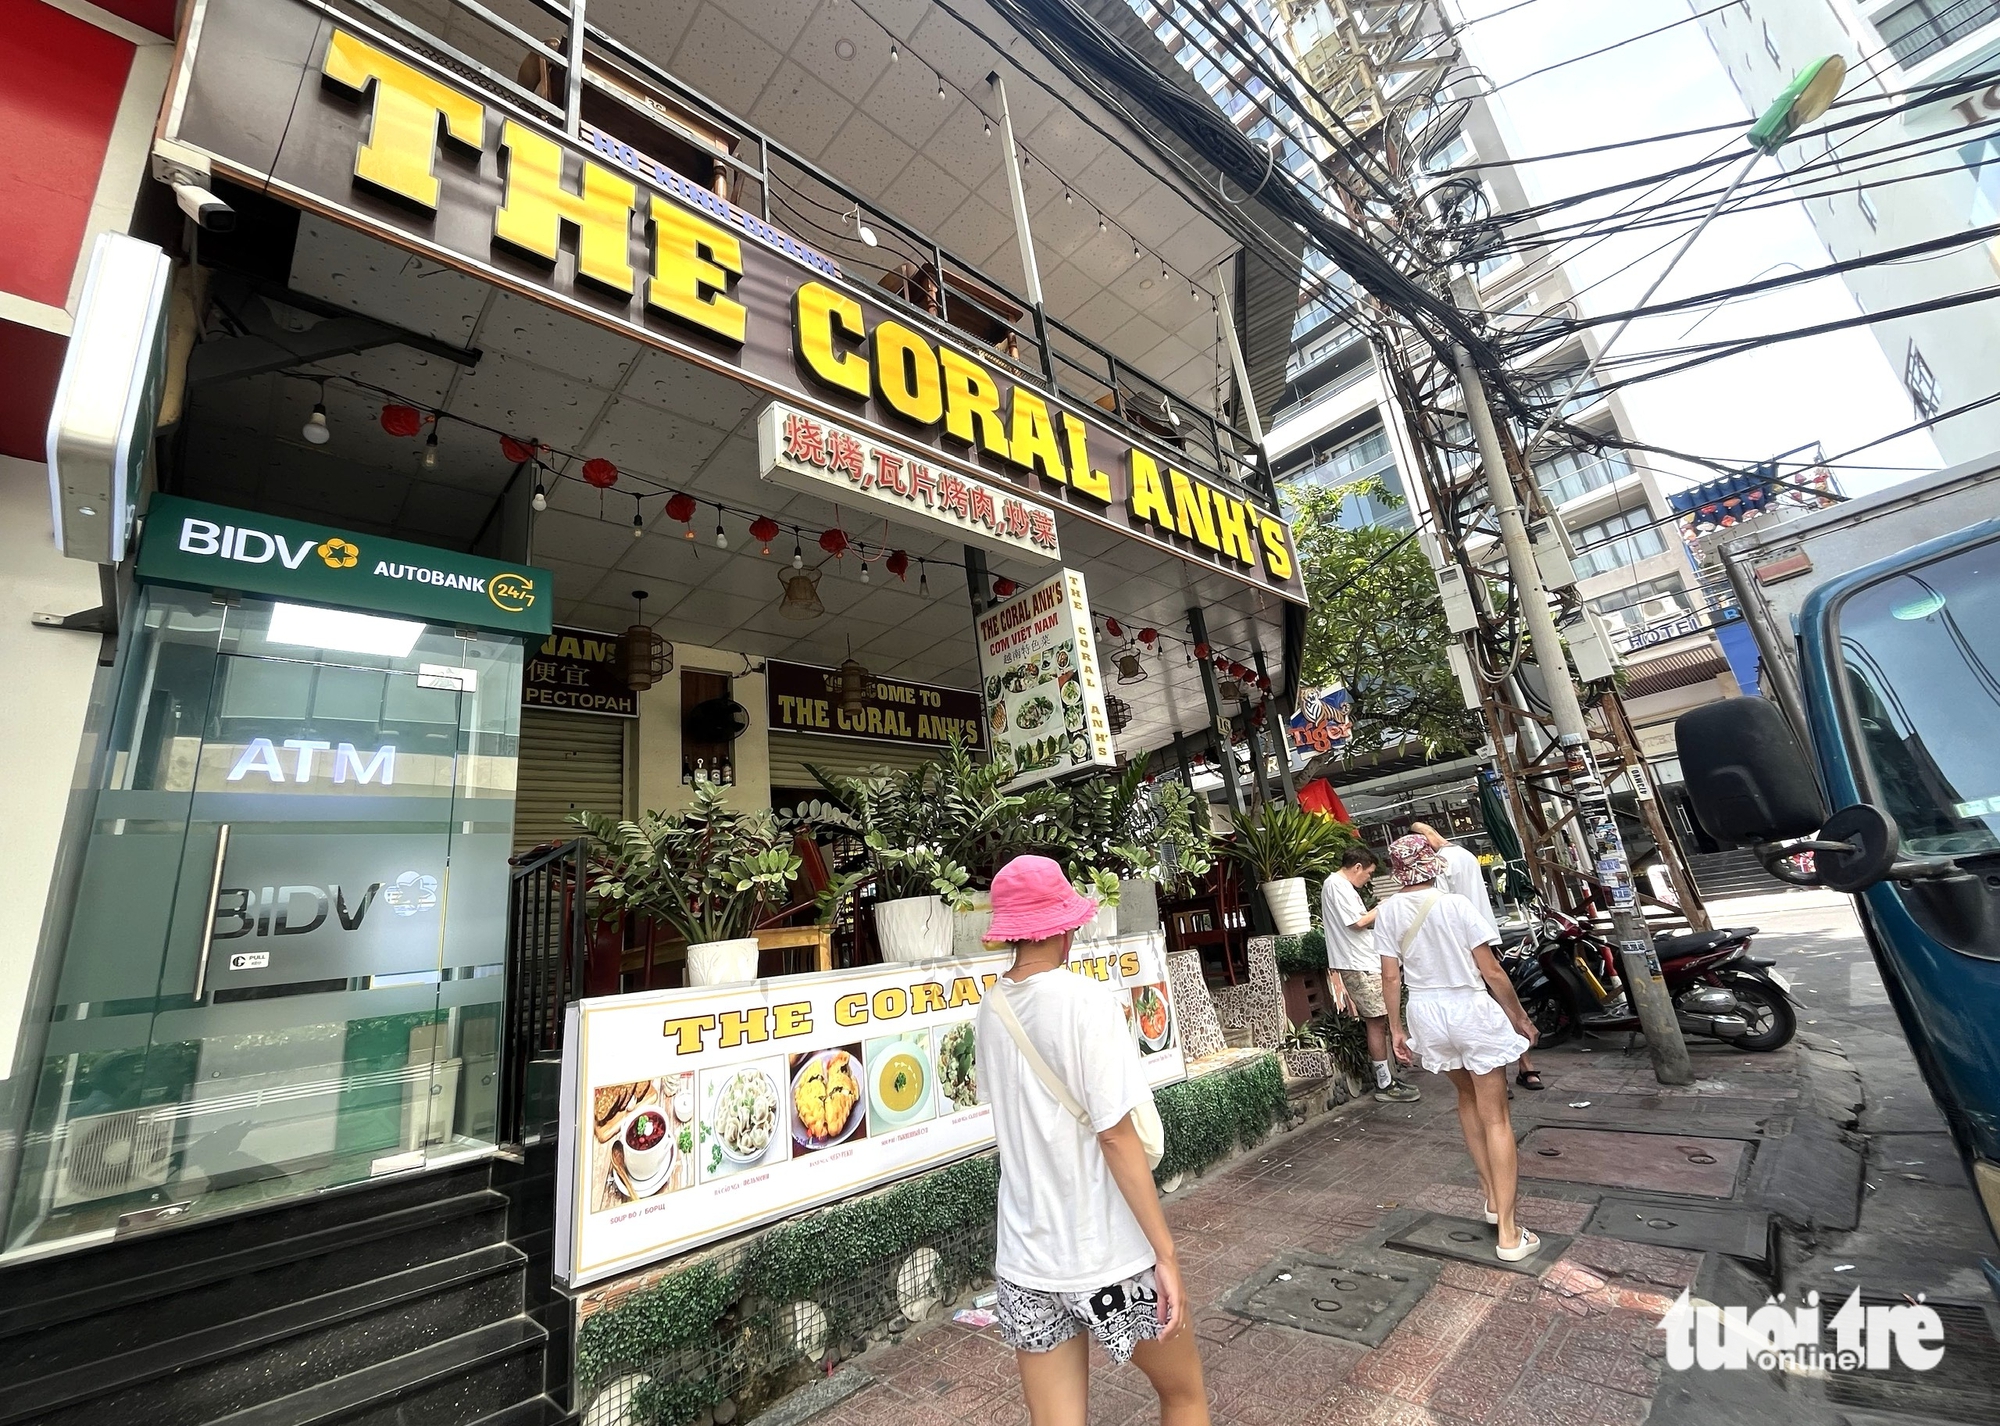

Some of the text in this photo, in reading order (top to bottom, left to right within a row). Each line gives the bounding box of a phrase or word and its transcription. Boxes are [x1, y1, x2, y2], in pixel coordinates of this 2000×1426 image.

[654, 166, 732, 222] KINH
[743, 214, 836, 277] DOANH
[321, 28, 1294, 580] THE CORAL ANH'S
[178, 517, 318, 570] BIDV
[374, 560, 486, 594] AUTOBANK
[497, 583, 535, 607] 24/7
[981, 580, 1063, 642] THE CORAL ANH'S
[1034, 612, 1059, 635] NAM
[1069, 576, 1082, 610] THE
[1078, 627, 1095, 687] CORAL
[526, 658, 591, 687] 便宜
[526, 687, 631, 712] РЕСТОРАН
[778, 695, 830, 728] THE
[917, 714, 978, 744] ANH'S
[919, 689, 941, 708] TO
[1288, 719, 1353, 751] Tiger
[226, 738, 396, 785] ATM
[213, 882, 382, 940] BIDV
[664, 1001, 813, 1055] THE
